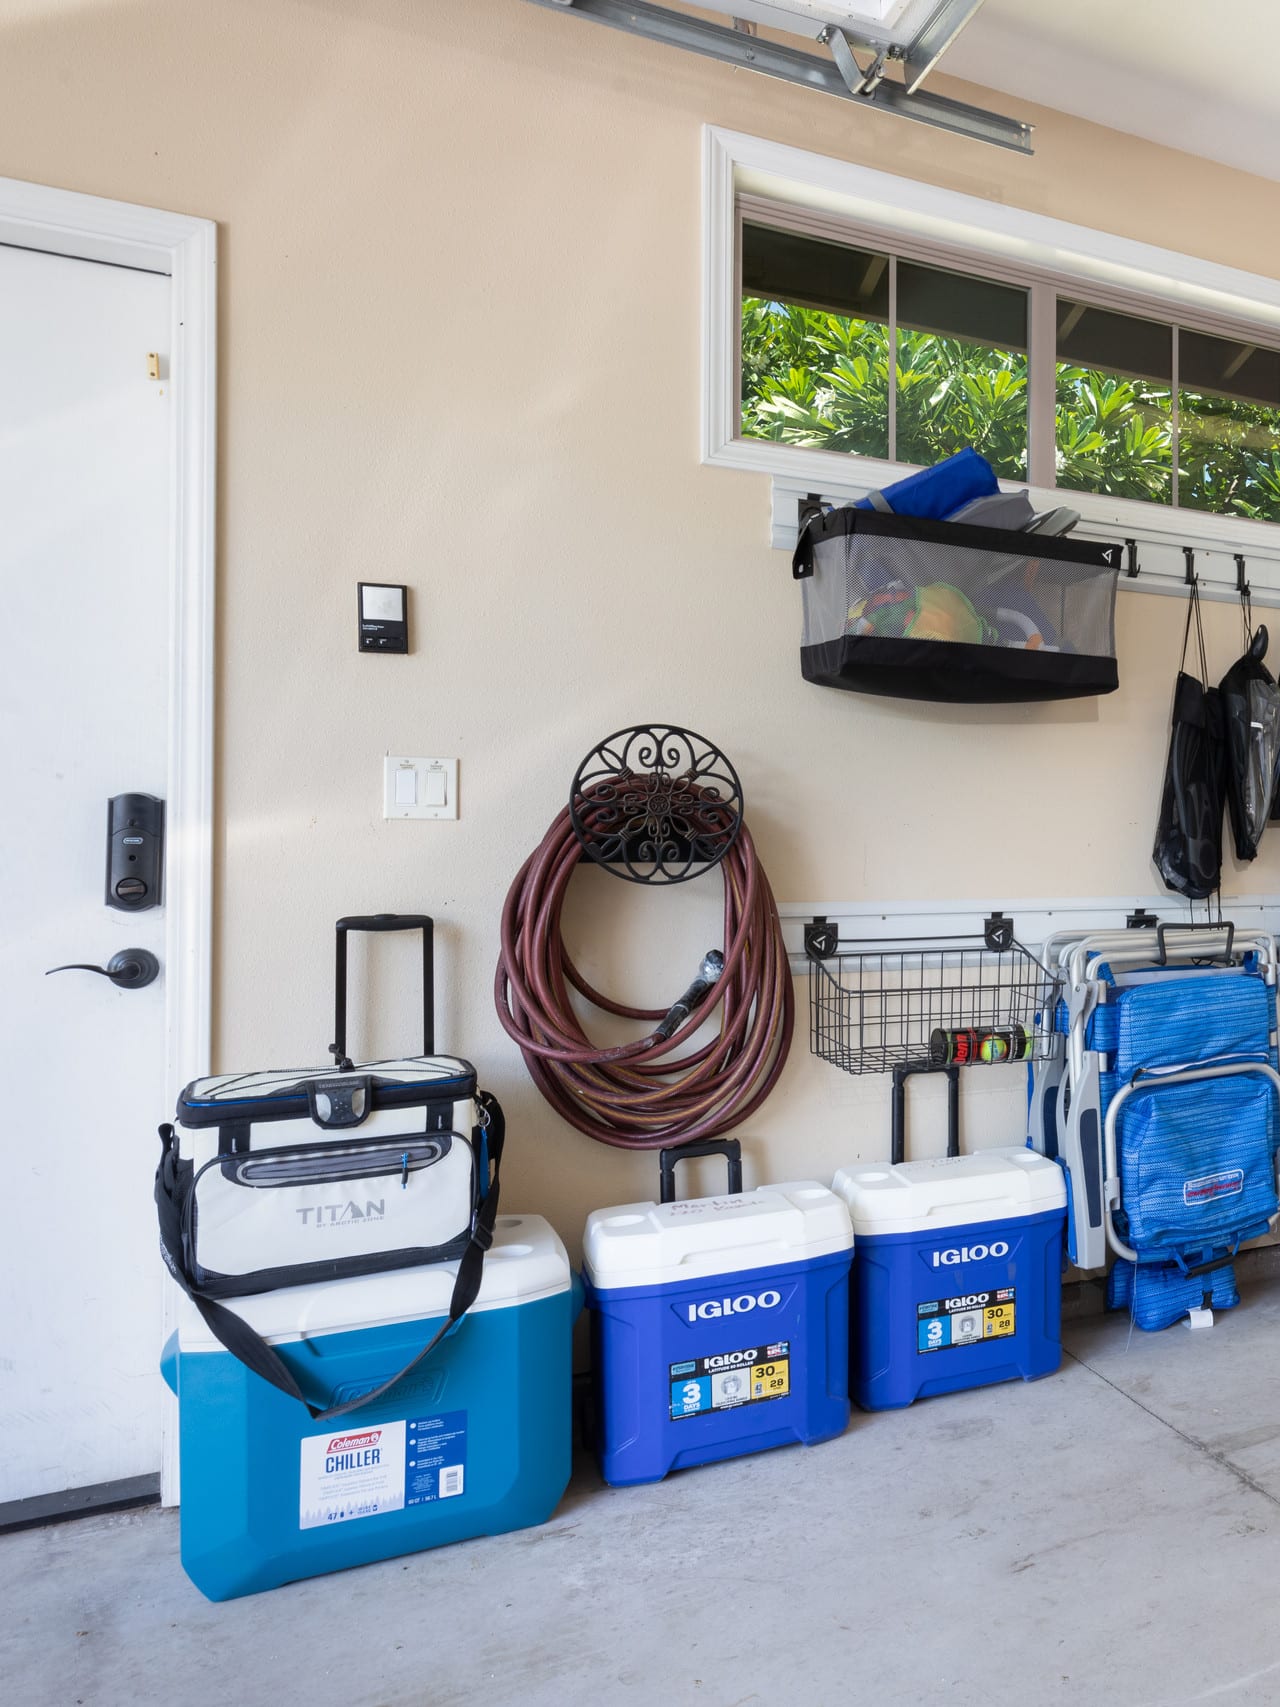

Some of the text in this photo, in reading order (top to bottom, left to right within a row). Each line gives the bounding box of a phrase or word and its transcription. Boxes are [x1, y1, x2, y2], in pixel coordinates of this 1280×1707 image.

[296, 1199, 385, 1225] TITAN
[932, 1241, 1009, 1267] IGLOO
[688, 1290, 781, 1322] IGLOO
[945, 1293, 990, 1310] IGLOO
[987, 1308, 1004, 1319] 30
[927, 1321, 943, 1340] 3
[999, 1320, 1011, 1328] 28
[704, 1349, 758, 1369] IGLOO
[755, 1366, 775, 1378] 30
[770, 1378, 784, 1388] 28
[682, 1383, 701, 1404] 3
[684, 1403, 700, 1411] DAYS
[331, 1435, 370, 1450] Coleman
[326, 1448, 381, 1474] CHILLER
[328, 1511, 338, 1521] 47
